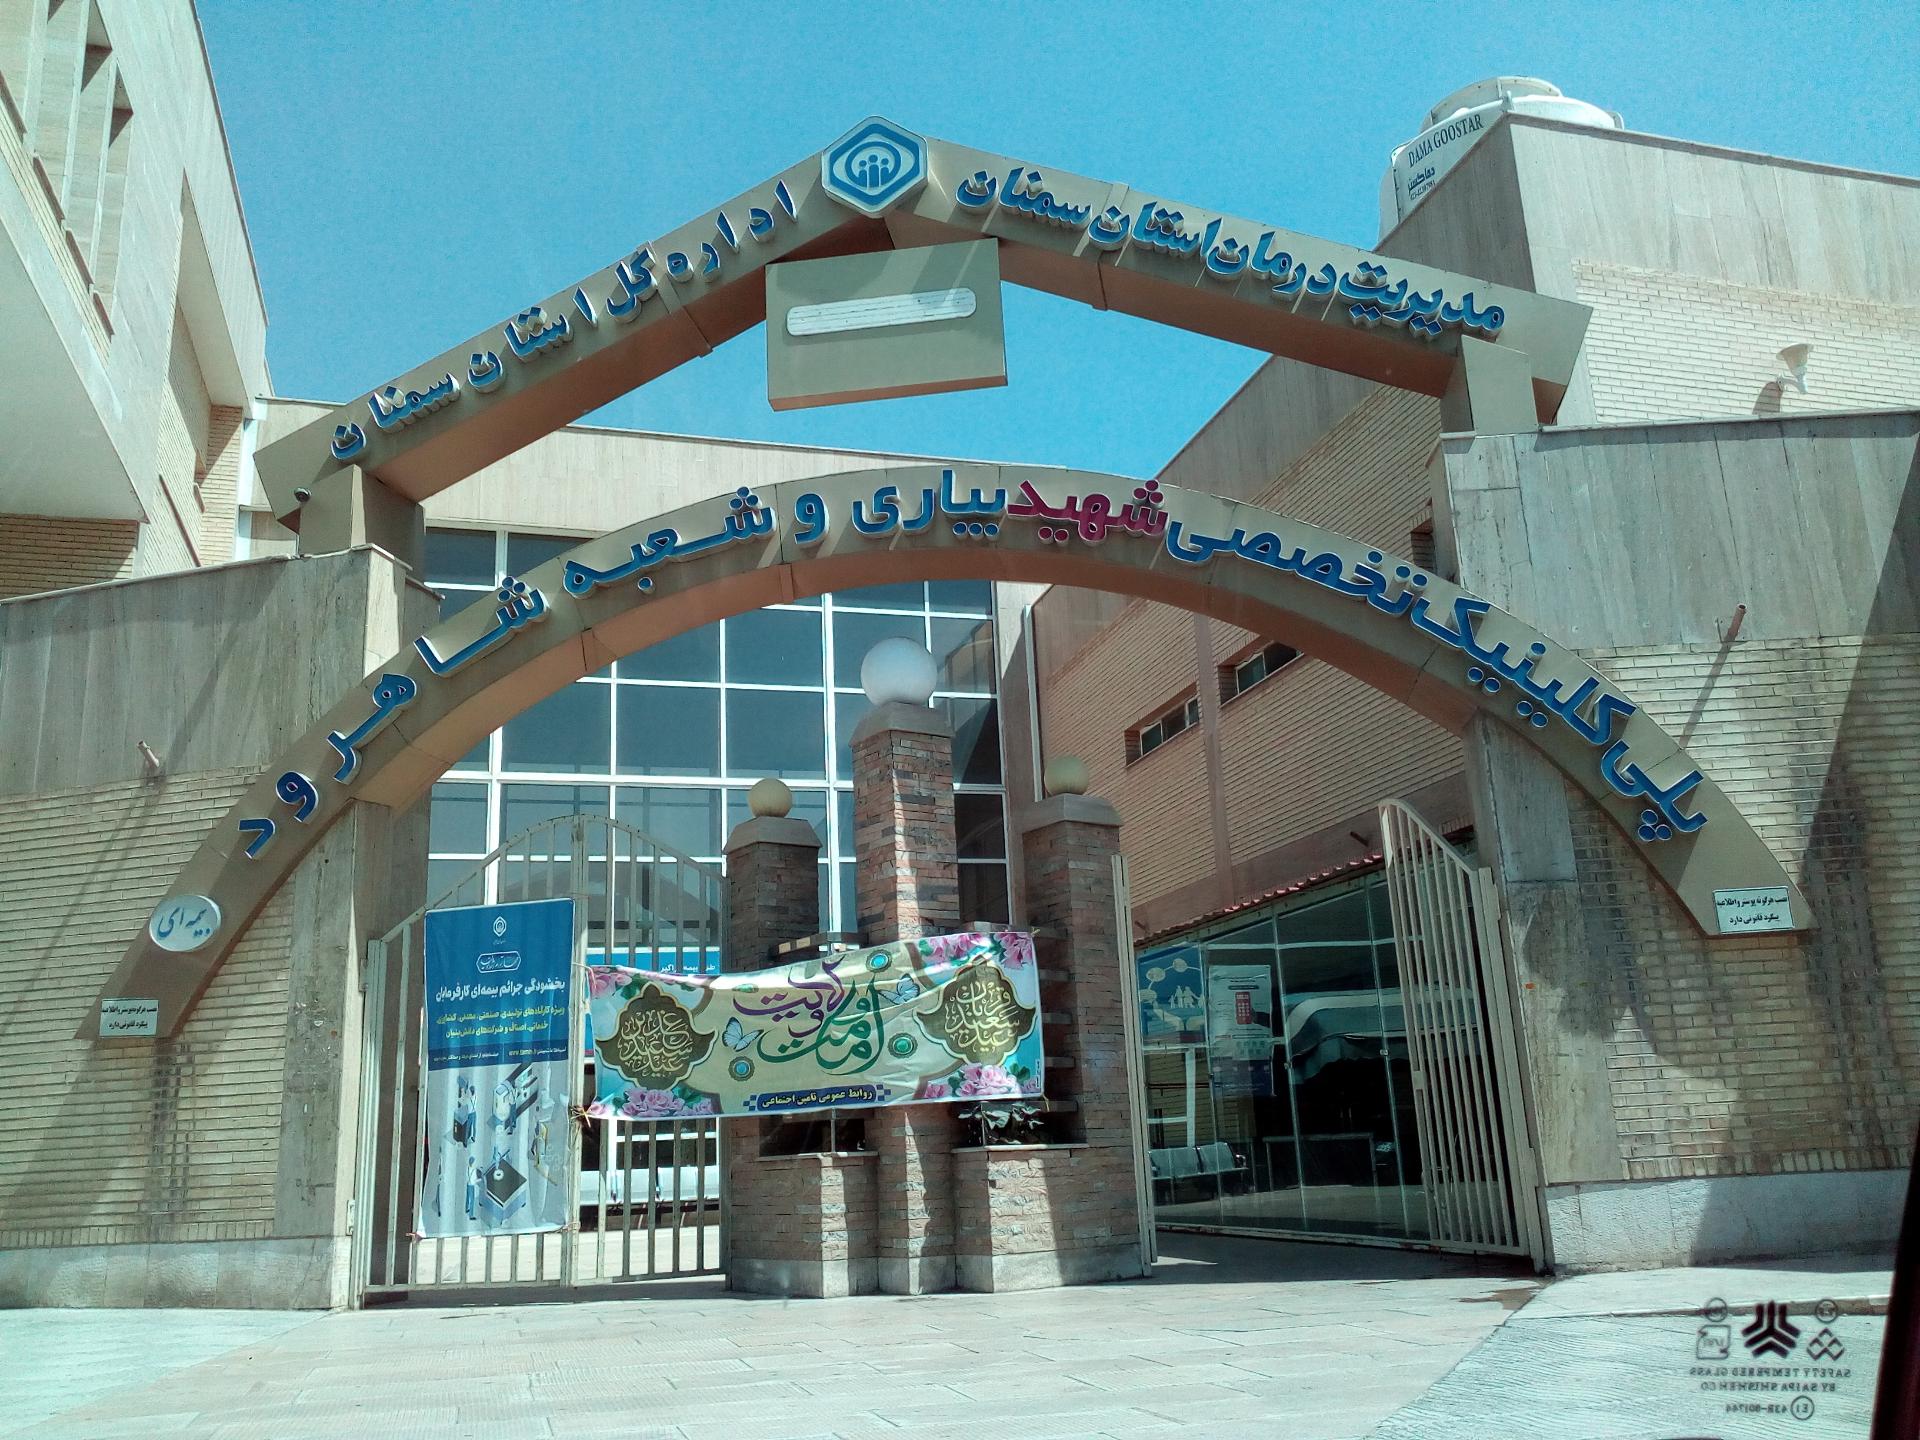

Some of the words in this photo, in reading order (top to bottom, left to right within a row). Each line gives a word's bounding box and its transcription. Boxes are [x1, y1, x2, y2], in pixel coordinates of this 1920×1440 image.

[1408, 140, 1434, 168] DAMA
[1433, 114, 1484, 149] GOOSTAR
[956, 166, 1091, 229] سمنان
[1088, 201, 1221, 256] استان
[666, 179, 799, 284] اداره
[1207, 230, 1337, 296] درمان
[606, 246, 658, 323] کل
[1338, 262, 1505, 338] مدیریت
[467, 286, 598, 394] استان
[330, 370, 460, 462] سمنان
[794, 493, 827, 545] و
[852, 469, 1007, 540] بیاری
[1007, 478, 1170, 545] شهید
[563, 486, 777, 598] شعبه
[1166, 519, 1428, 617] تخصصی
[1410, 596, 1637, 746] کلینیک
[238, 576, 549, 860] شاهرود
[1601, 739, 1708, 843] پلی
[1729, 915, 1743, 925] دارد
[435, 981, 471, 1003] کارفرمایان
[499, 979, 523, 997] جرائم
[524, 976, 566, 995] بخشودگی
[761, 1093, 796, 1108] اجتماعی
[797, 1092, 817, 1106] تامین
[818, 1091, 846, 1104] عمومی
[848, 1087, 873, 1100] روابط
